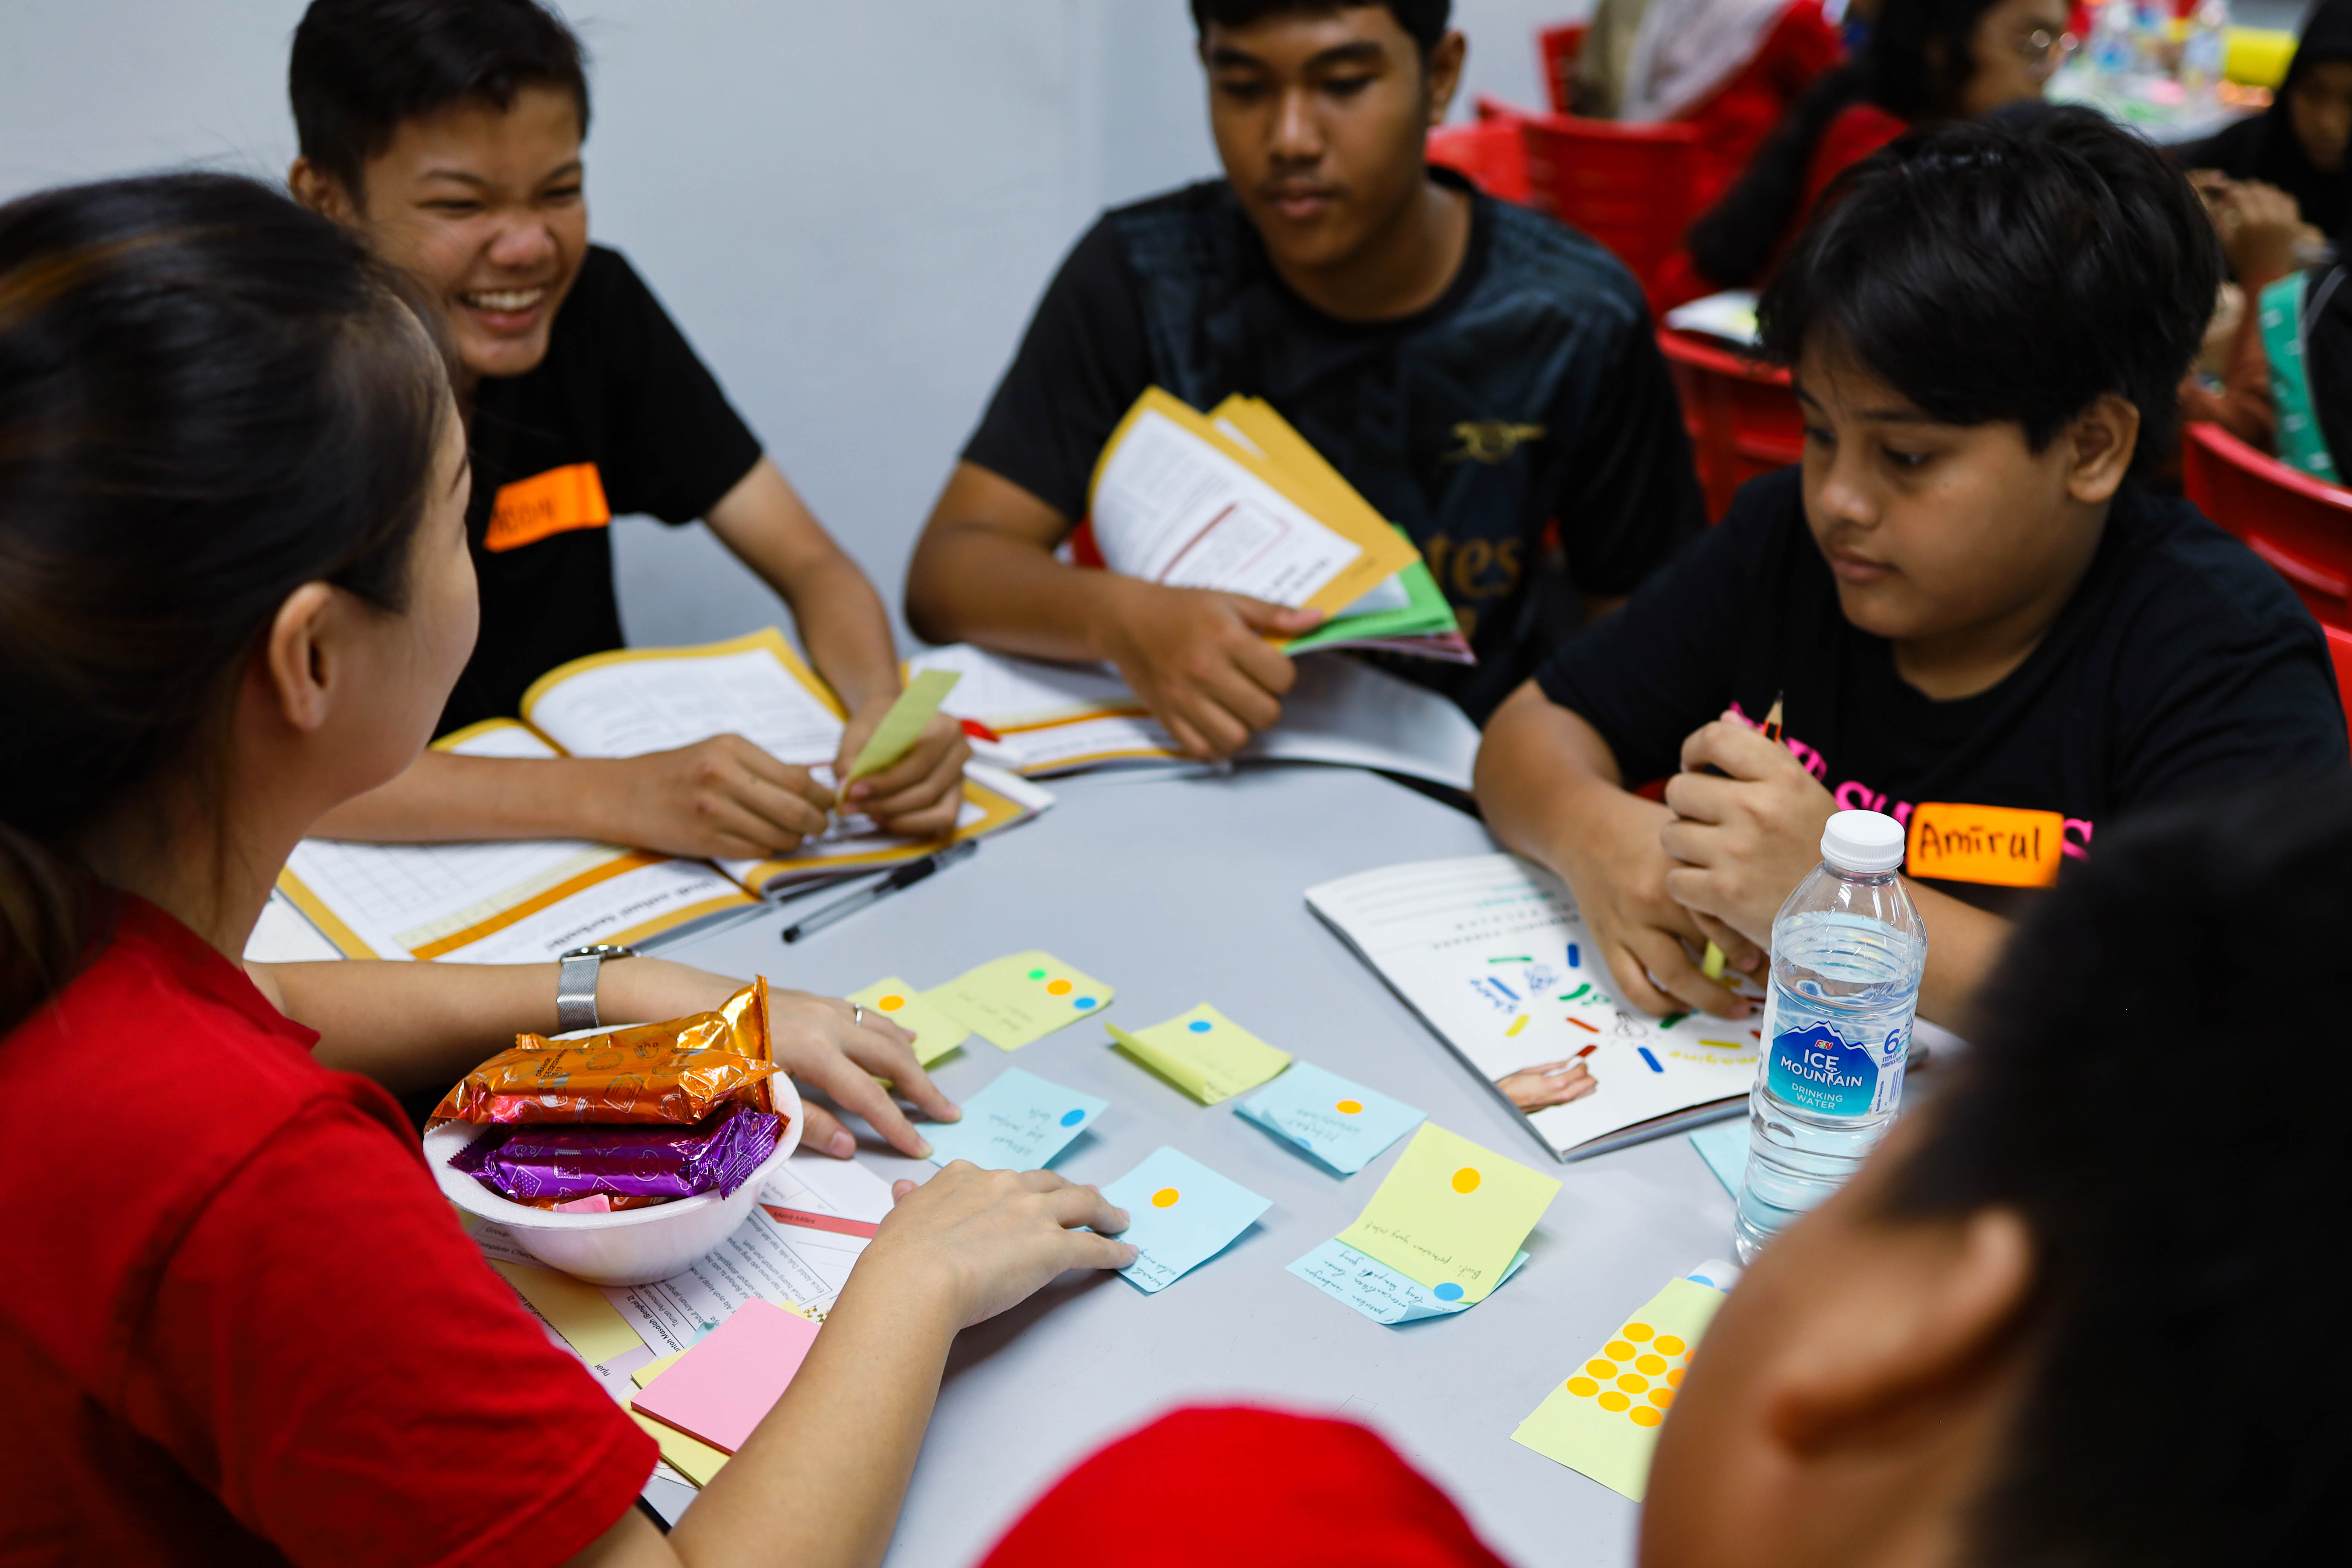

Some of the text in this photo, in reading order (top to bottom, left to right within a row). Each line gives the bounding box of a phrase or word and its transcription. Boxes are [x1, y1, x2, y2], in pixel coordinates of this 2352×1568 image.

[1920, 821, 2041, 859] Amirul
[1815, 1039, 1834, 1050] F&N
[1884, 1029, 1900, 1054] 6
[536, 1058, 553, 1076] ORANGE
[1804, 1049, 1839, 1072] ICE
[1882, 1055, 1893, 1063] STEPS
[1781, 1055, 1863, 1088] MOUNTAIN
[1792, 1083, 1843, 1102] DRINKING
[1796, 1093, 1835, 1110] WATER
[626, 1293, 635, 1303] 2)
[642, 1287, 666, 1313] Permainan
[631, 1298, 652, 1321] (Bengkel
[662, 1309, 680, 1328] Taman
[648, 1318, 669, 1341] Masalah
